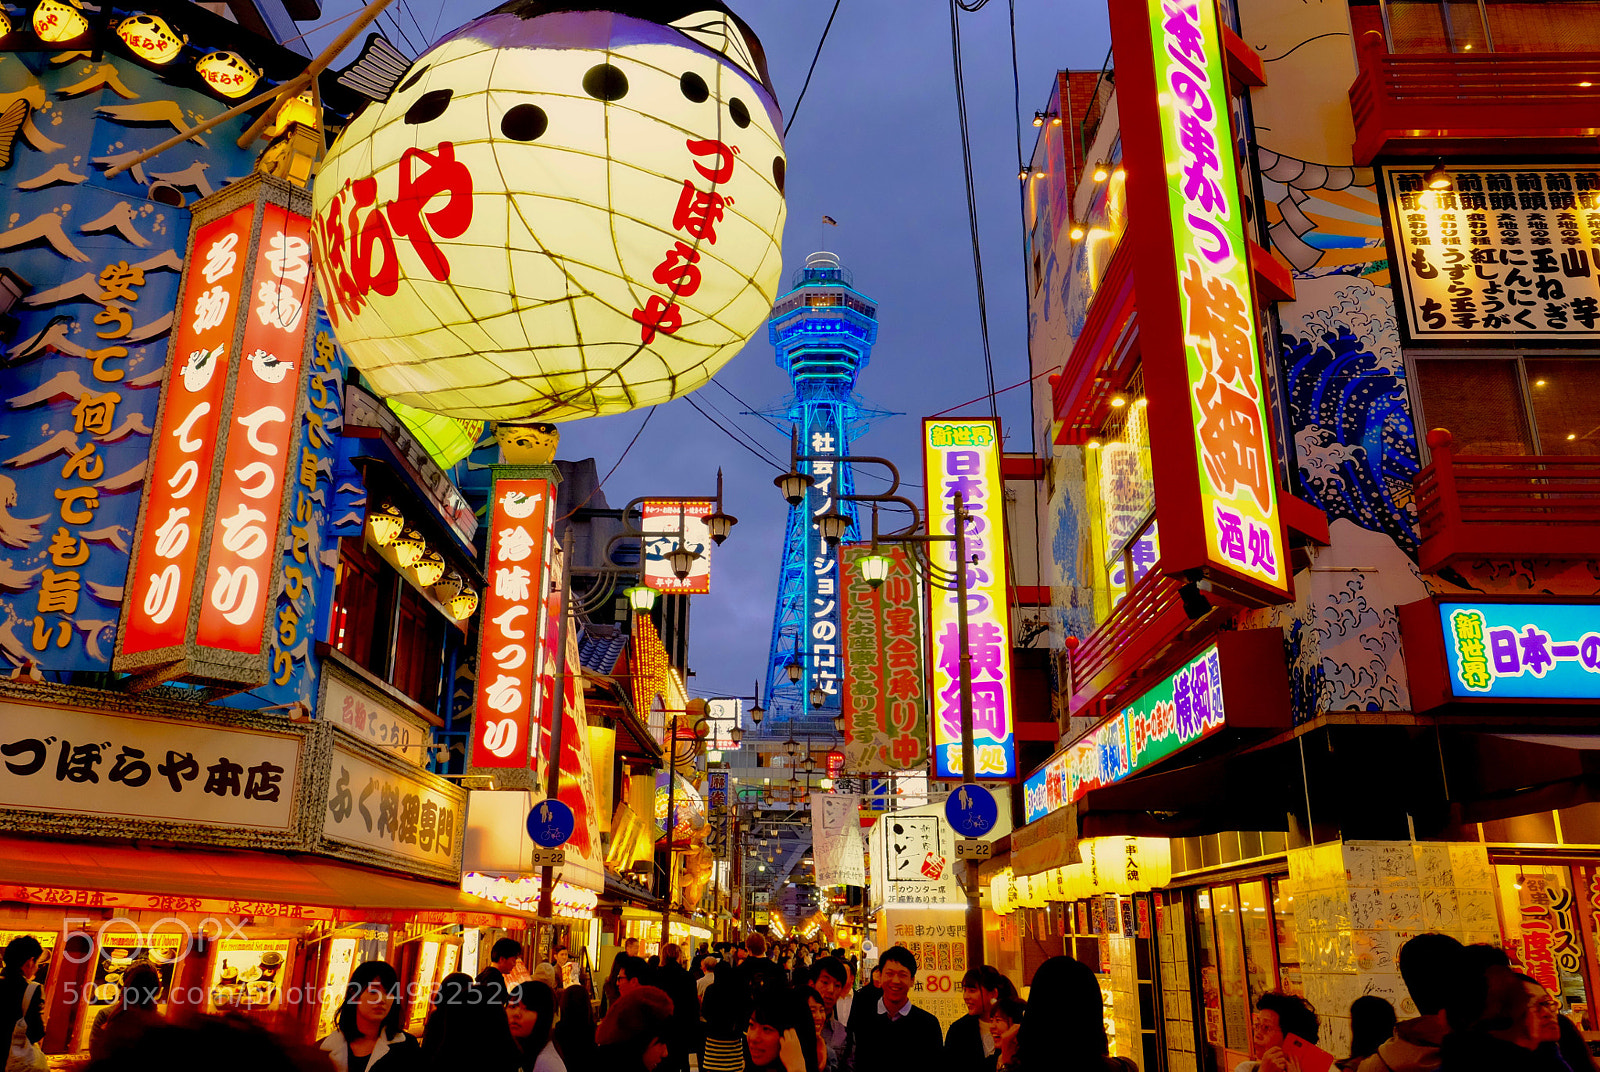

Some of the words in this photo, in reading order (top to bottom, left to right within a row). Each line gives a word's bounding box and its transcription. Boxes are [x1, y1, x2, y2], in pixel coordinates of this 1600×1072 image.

[1456, 174, 1488, 211] 前頭
[1485, 174, 1518, 211] 前頭
[1515, 174, 1548, 211] 前頭
[1544, 174, 1578, 211] 前頭
[632, 138, 741, 344] づぼらや
[1411, 248, 1447, 330] もち
[1442, 248, 1480, 330] うずら玉子
[1470, 248, 1511, 329] 紅しょうが
[1500, 249, 1538, 330] にんにく
[1530, 248, 1570, 330] 玉ねぎ
[1560, 247, 1600, 330] 山芋
[32, 260, 146, 651] 安うて何んでも旨い
[931, 426, 993, 447] 新世界
[143, 402, 211, 625] てっちり
[210, 406, 286, 626] てっちり
[273, 331, 336, 687] 安うて旨いてっちり
[1217, 505, 1275, 576] 酒処
[812, 432, 837, 695] 社会イノーションの日立
[939, 622, 1007, 740] 横綱
[1453, 612, 1491, 689] 新世界
[1489, 627, 1600, 675] 日本一の
[342, 695, 410, 754] 名物てっちり
[1174, 659, 1211, 741] 横綱
[1, 736, 285, 803] づぼらや本店
[329, 765, 454, 857] ふぐ料理専門
[1546, 887, 1582, 970] ソースの
[926, 975, 951, 992] 80
